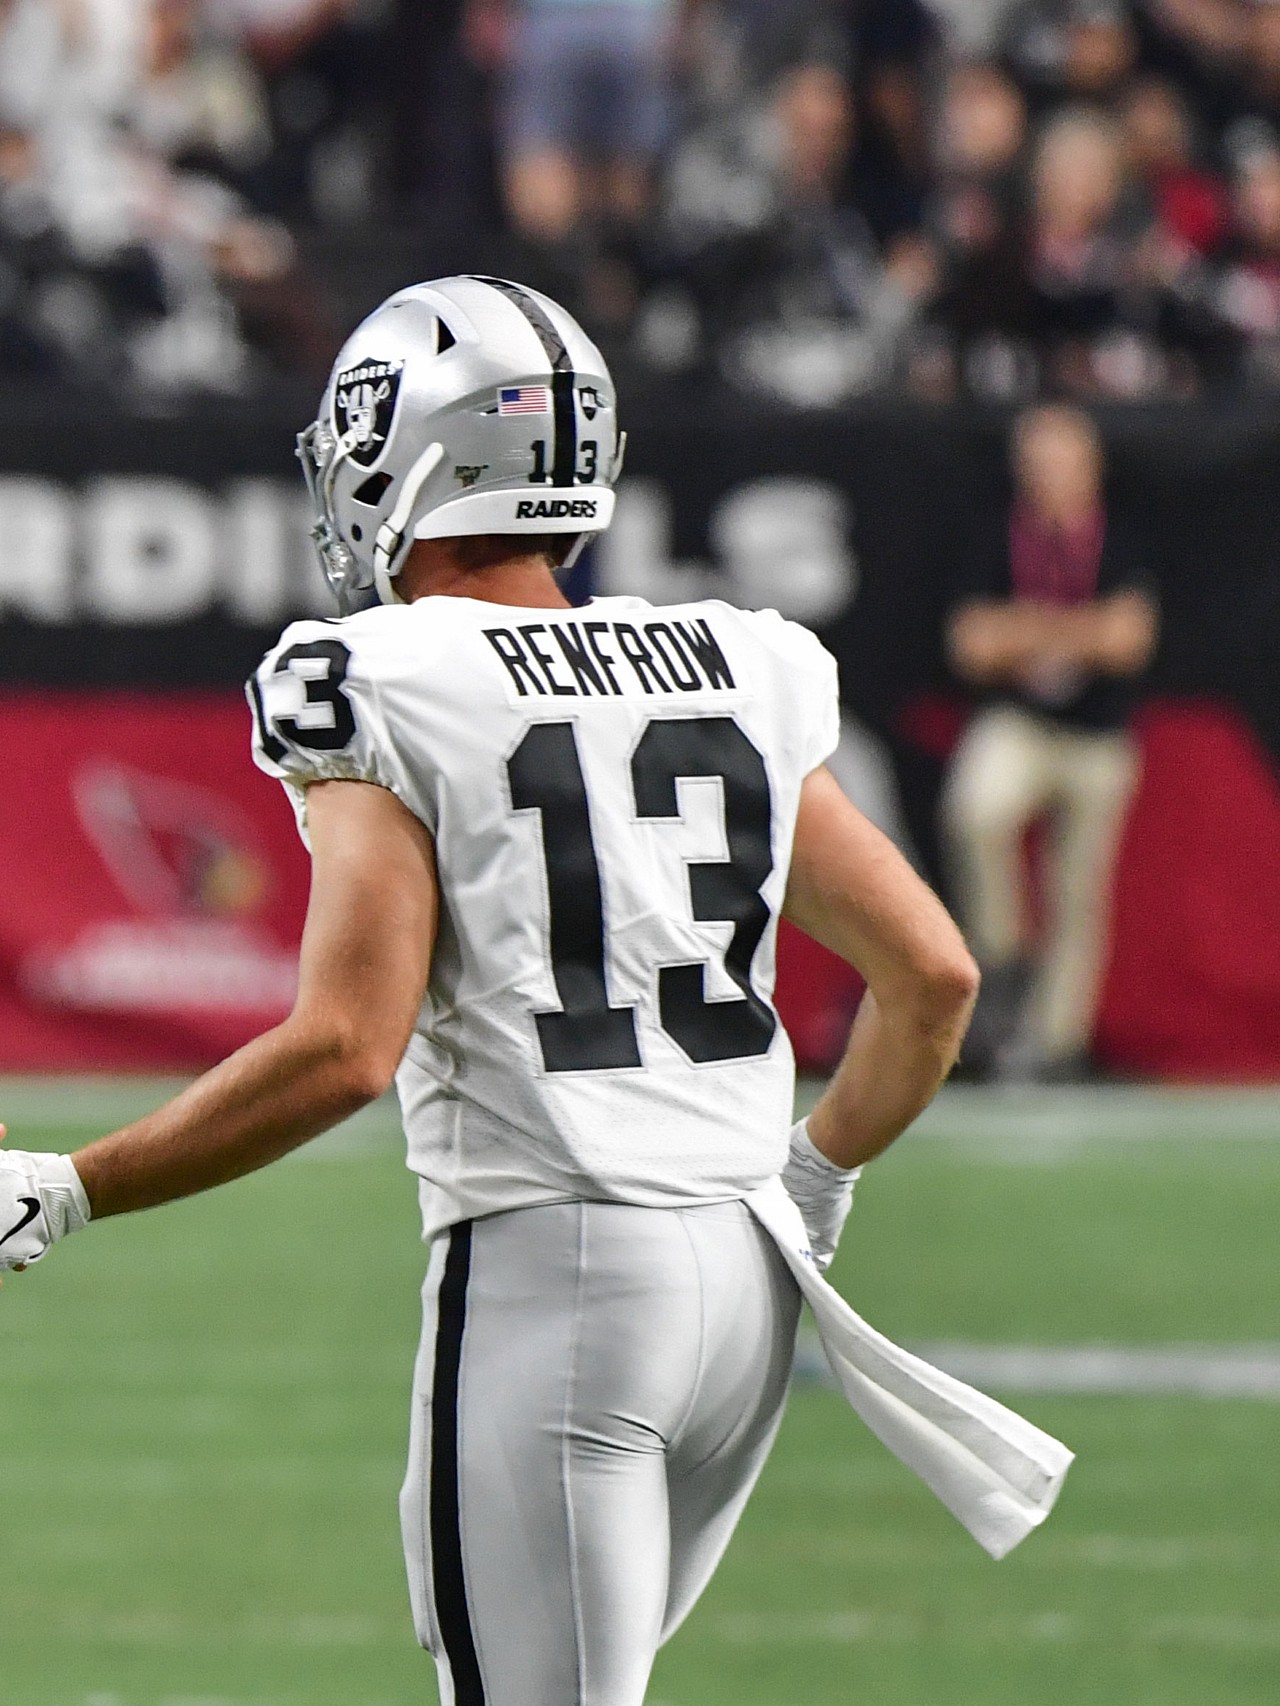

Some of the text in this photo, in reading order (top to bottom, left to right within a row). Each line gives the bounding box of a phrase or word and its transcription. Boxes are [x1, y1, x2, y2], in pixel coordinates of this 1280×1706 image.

[338, 363, 397, 386] RAIDERS
[516, 500, 598, 519] RAIDERS
[481, 619, 736, 696] RENFROW
[507, 716, 777, 1072] 13
